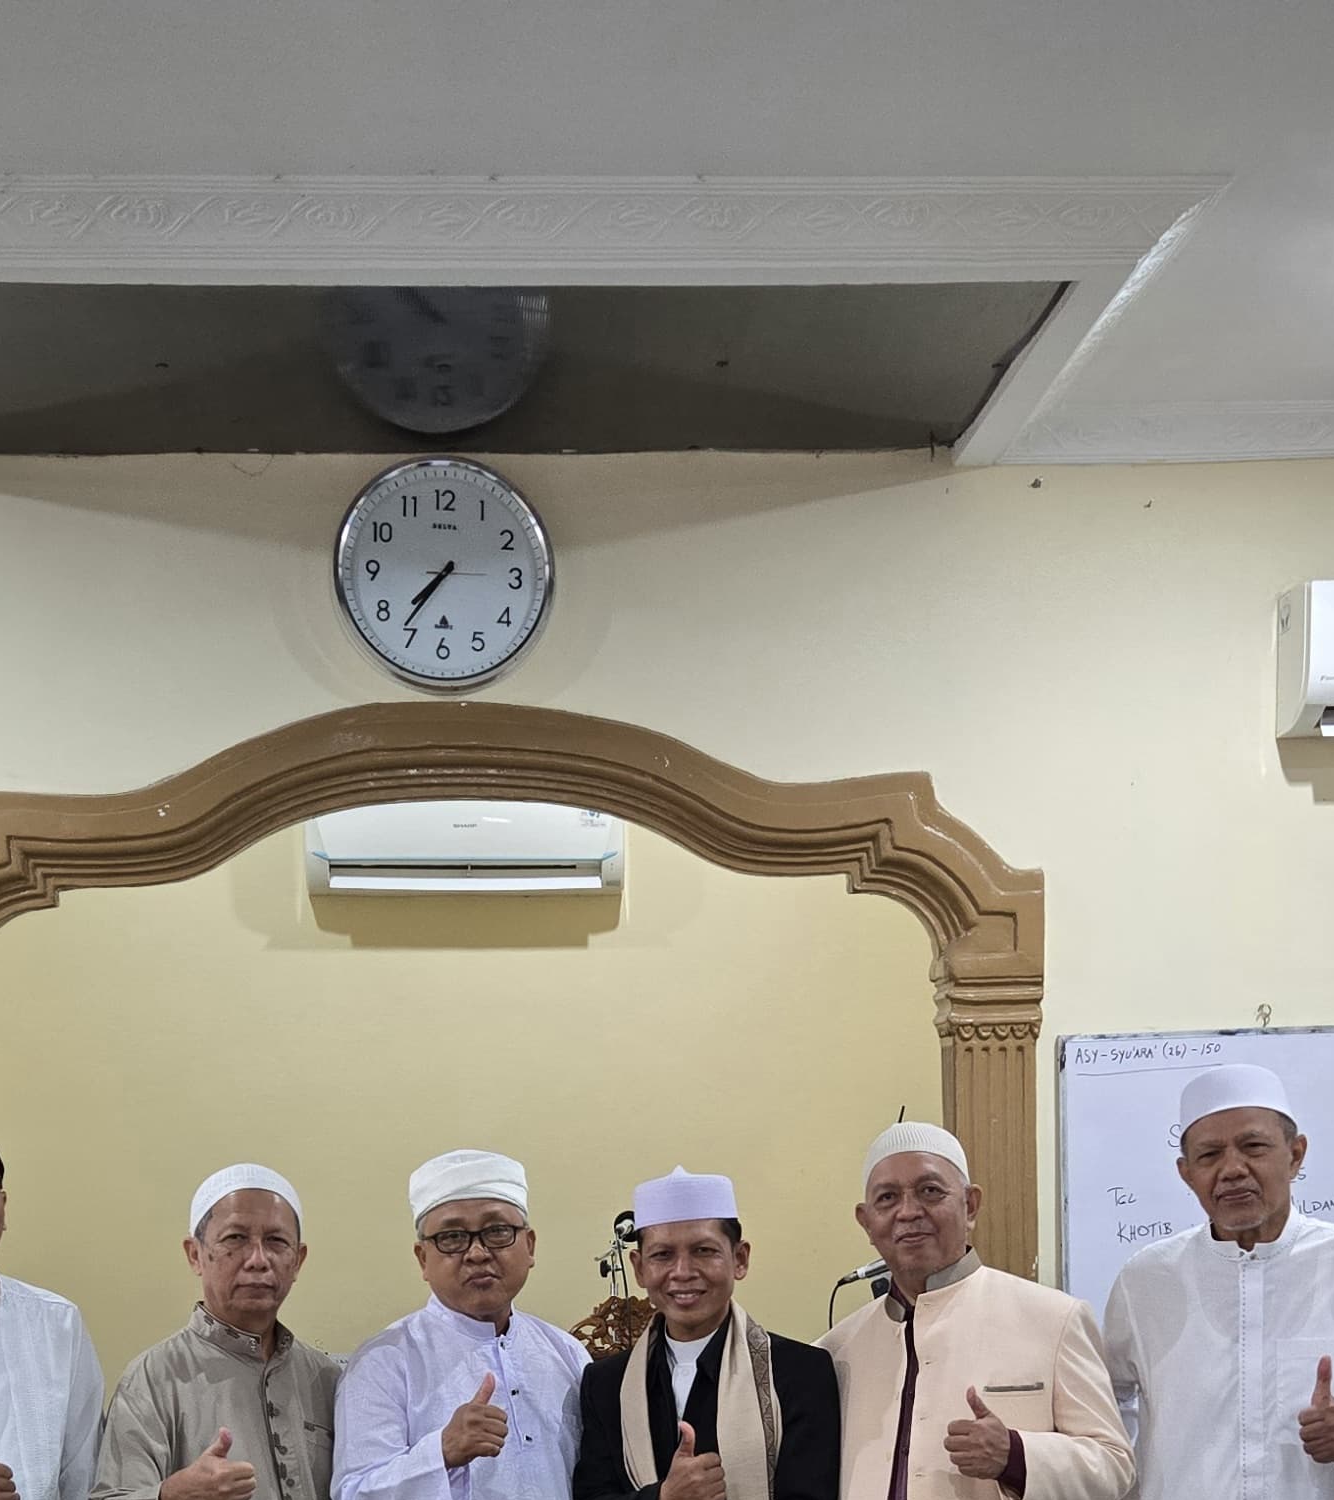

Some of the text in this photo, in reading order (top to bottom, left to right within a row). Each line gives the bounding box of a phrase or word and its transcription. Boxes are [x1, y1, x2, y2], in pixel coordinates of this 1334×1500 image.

[401, 495, 418, 518] 11
[434, 489, 456, 512] 12
[479, 499, 485, 522] 1
[372, 521, 393, 543] 10
[499, 529, 515, 551] 2
[365, 559, 381, 582] 9
[508, 567, 523, 590] 3
[376, 599, 391, 622] 8
[497, 606, 513, 627] 4
[402, 628, 418, 649] 7
[436, 637, 451, 660] 6
[471, 631, 486, 652] 5
